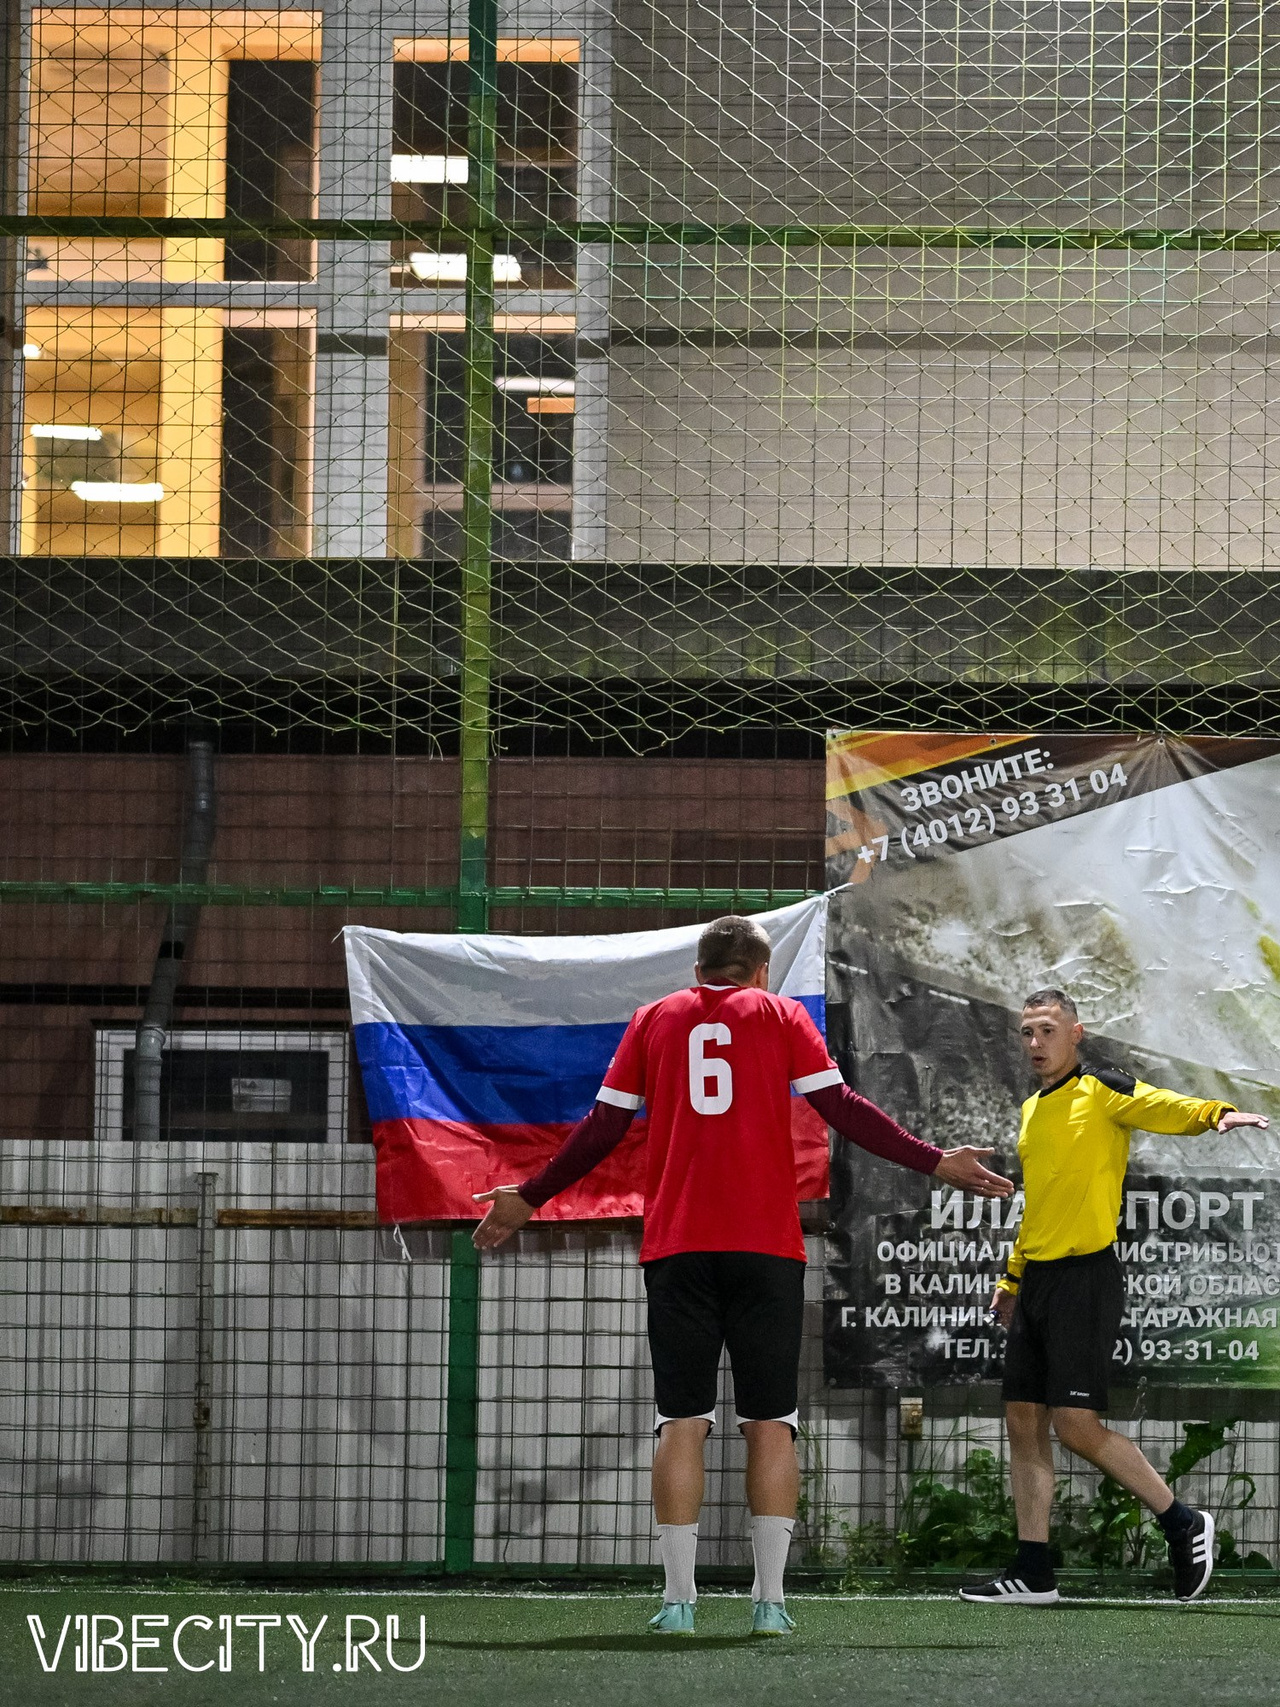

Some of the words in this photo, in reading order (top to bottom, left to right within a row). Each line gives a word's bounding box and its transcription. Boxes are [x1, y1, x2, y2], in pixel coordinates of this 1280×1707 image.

[900, 748, 1054, 813] ЗВОНИТЕ:
[857, 834, 889, 864] +7
[901, 803, 996, 858] (4012)
[1001, 790, 1041, 822] 93
[1047, 777, 1082, 809] 31
[1088, 763, 1129, 795] 04
[688, 1022, 733, 1116] 6
[1115, 1190, 1265, 1231] ПОРТ
[876, 1240, 1015, 1266] ОФИЦИАЛ
[885, 1273, 901, 1295] В
[841, 1306, 857, 1328] Г.
[1130, 1307, 1278, 1329] ГАРАЖНАЯ
[1140, 1339, 1260, 1362] 93-31-04
